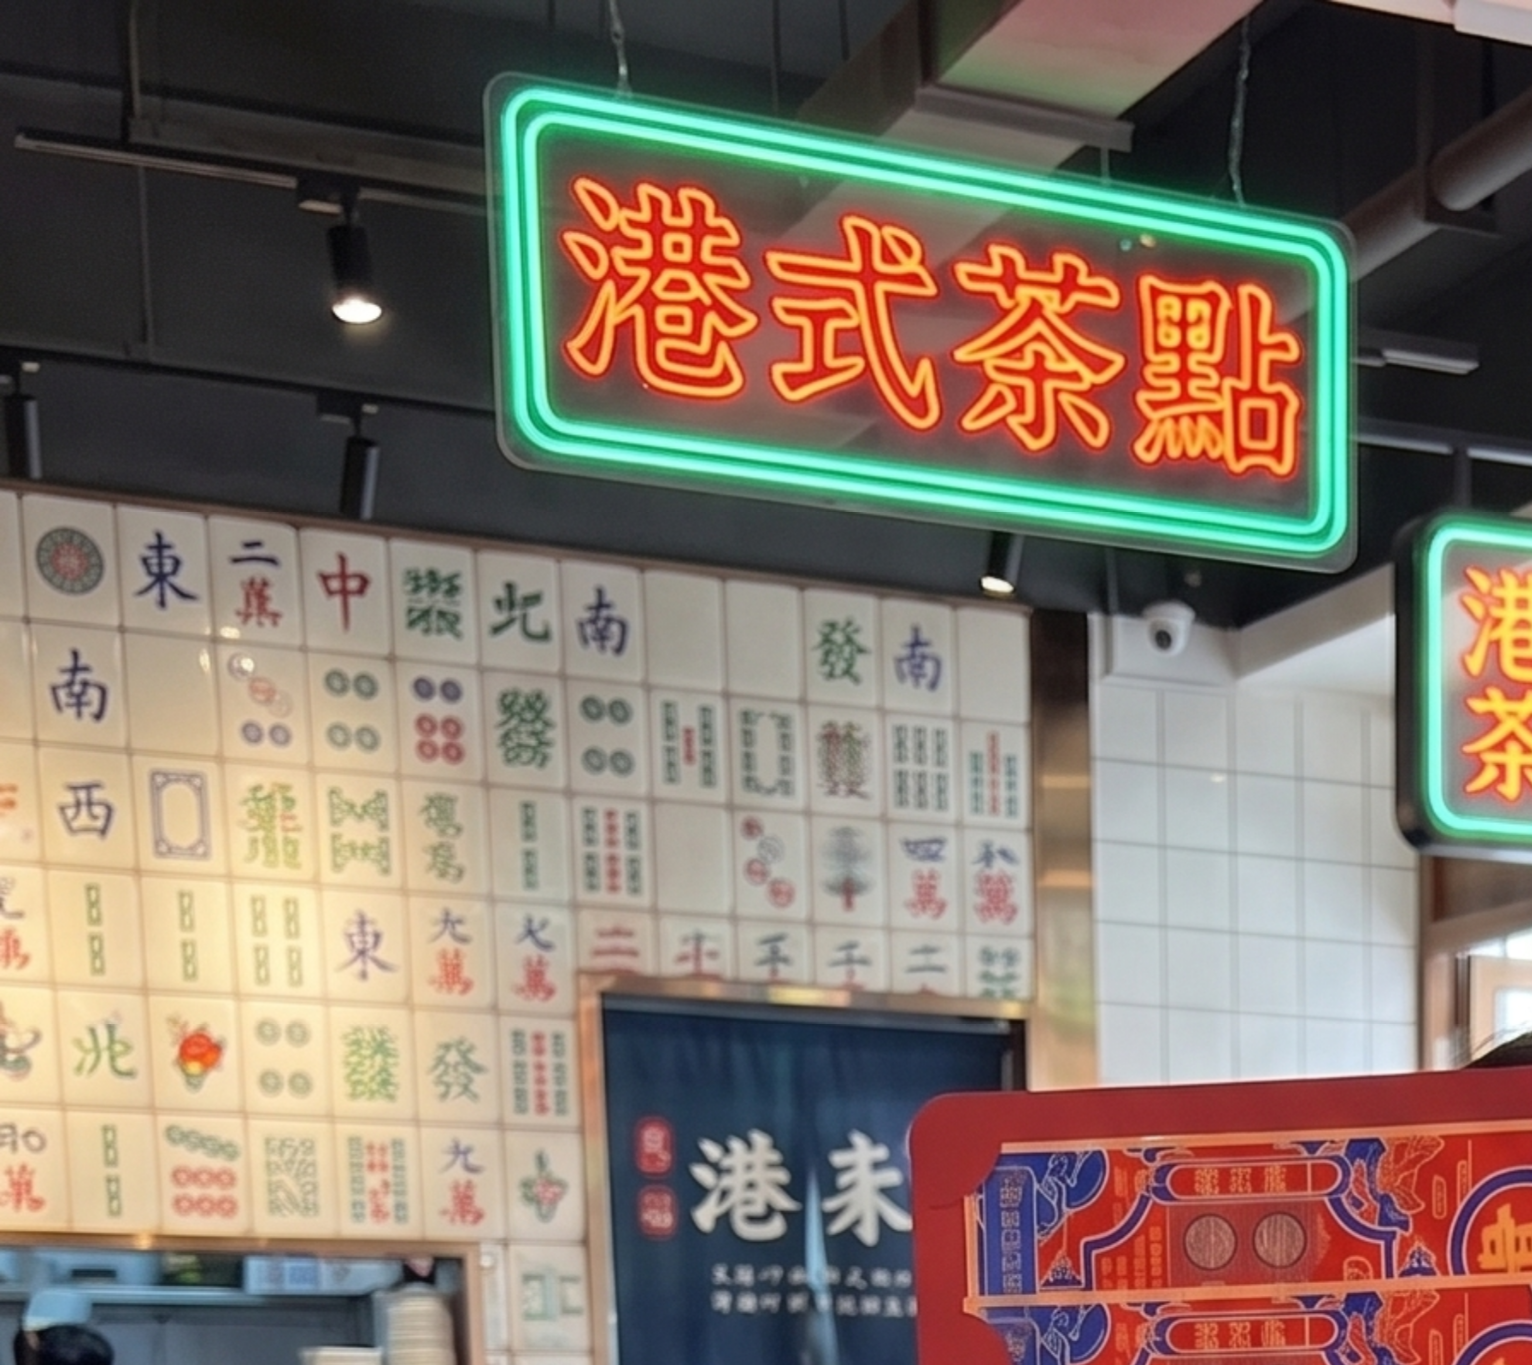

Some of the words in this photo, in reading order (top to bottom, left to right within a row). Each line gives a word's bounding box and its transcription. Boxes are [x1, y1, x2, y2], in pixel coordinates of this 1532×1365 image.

[562, 176, 1303, 479] 港式茶點
[134, 531, 198, 608] 東
[317, 552, 371, 632] 中
[576, 585, 629, 656] 南
[813, 616, 872, 685] 發
[50, 648, 108, 723] 南
[893, 625, 943, 691] 南
[58, 780, 115, 840] 西
[337, 909, 398, 981] 東
